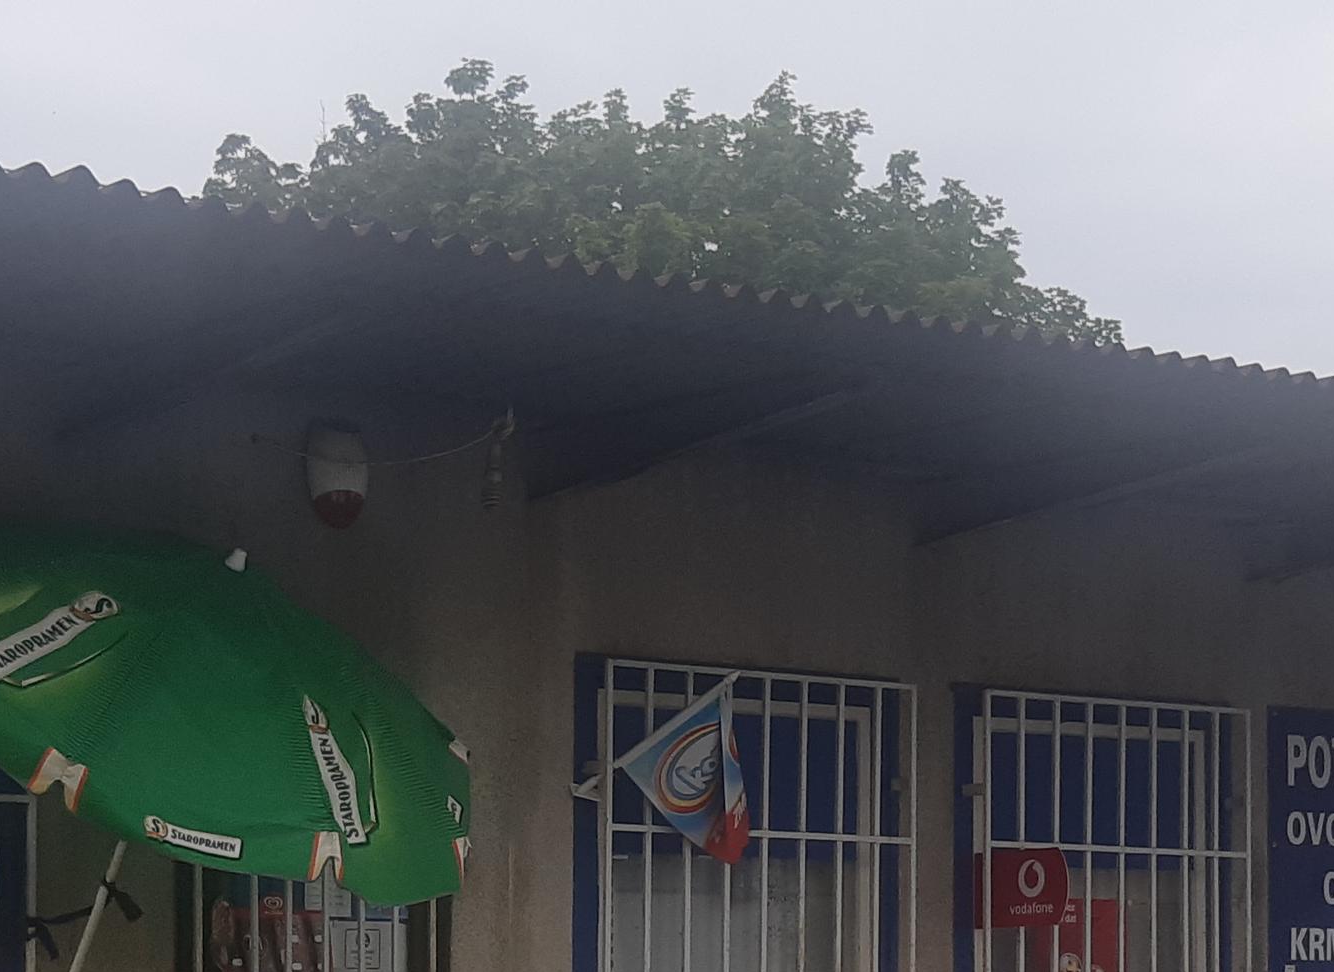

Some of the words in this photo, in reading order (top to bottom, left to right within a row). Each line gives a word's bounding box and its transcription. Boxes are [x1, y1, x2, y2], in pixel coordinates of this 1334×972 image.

[318, 737, 359, 838] STAROPRAMEN
[170, 828, 237, 852] STAROPRAMEN
[1009, 902, 1054, 915] vodafone
